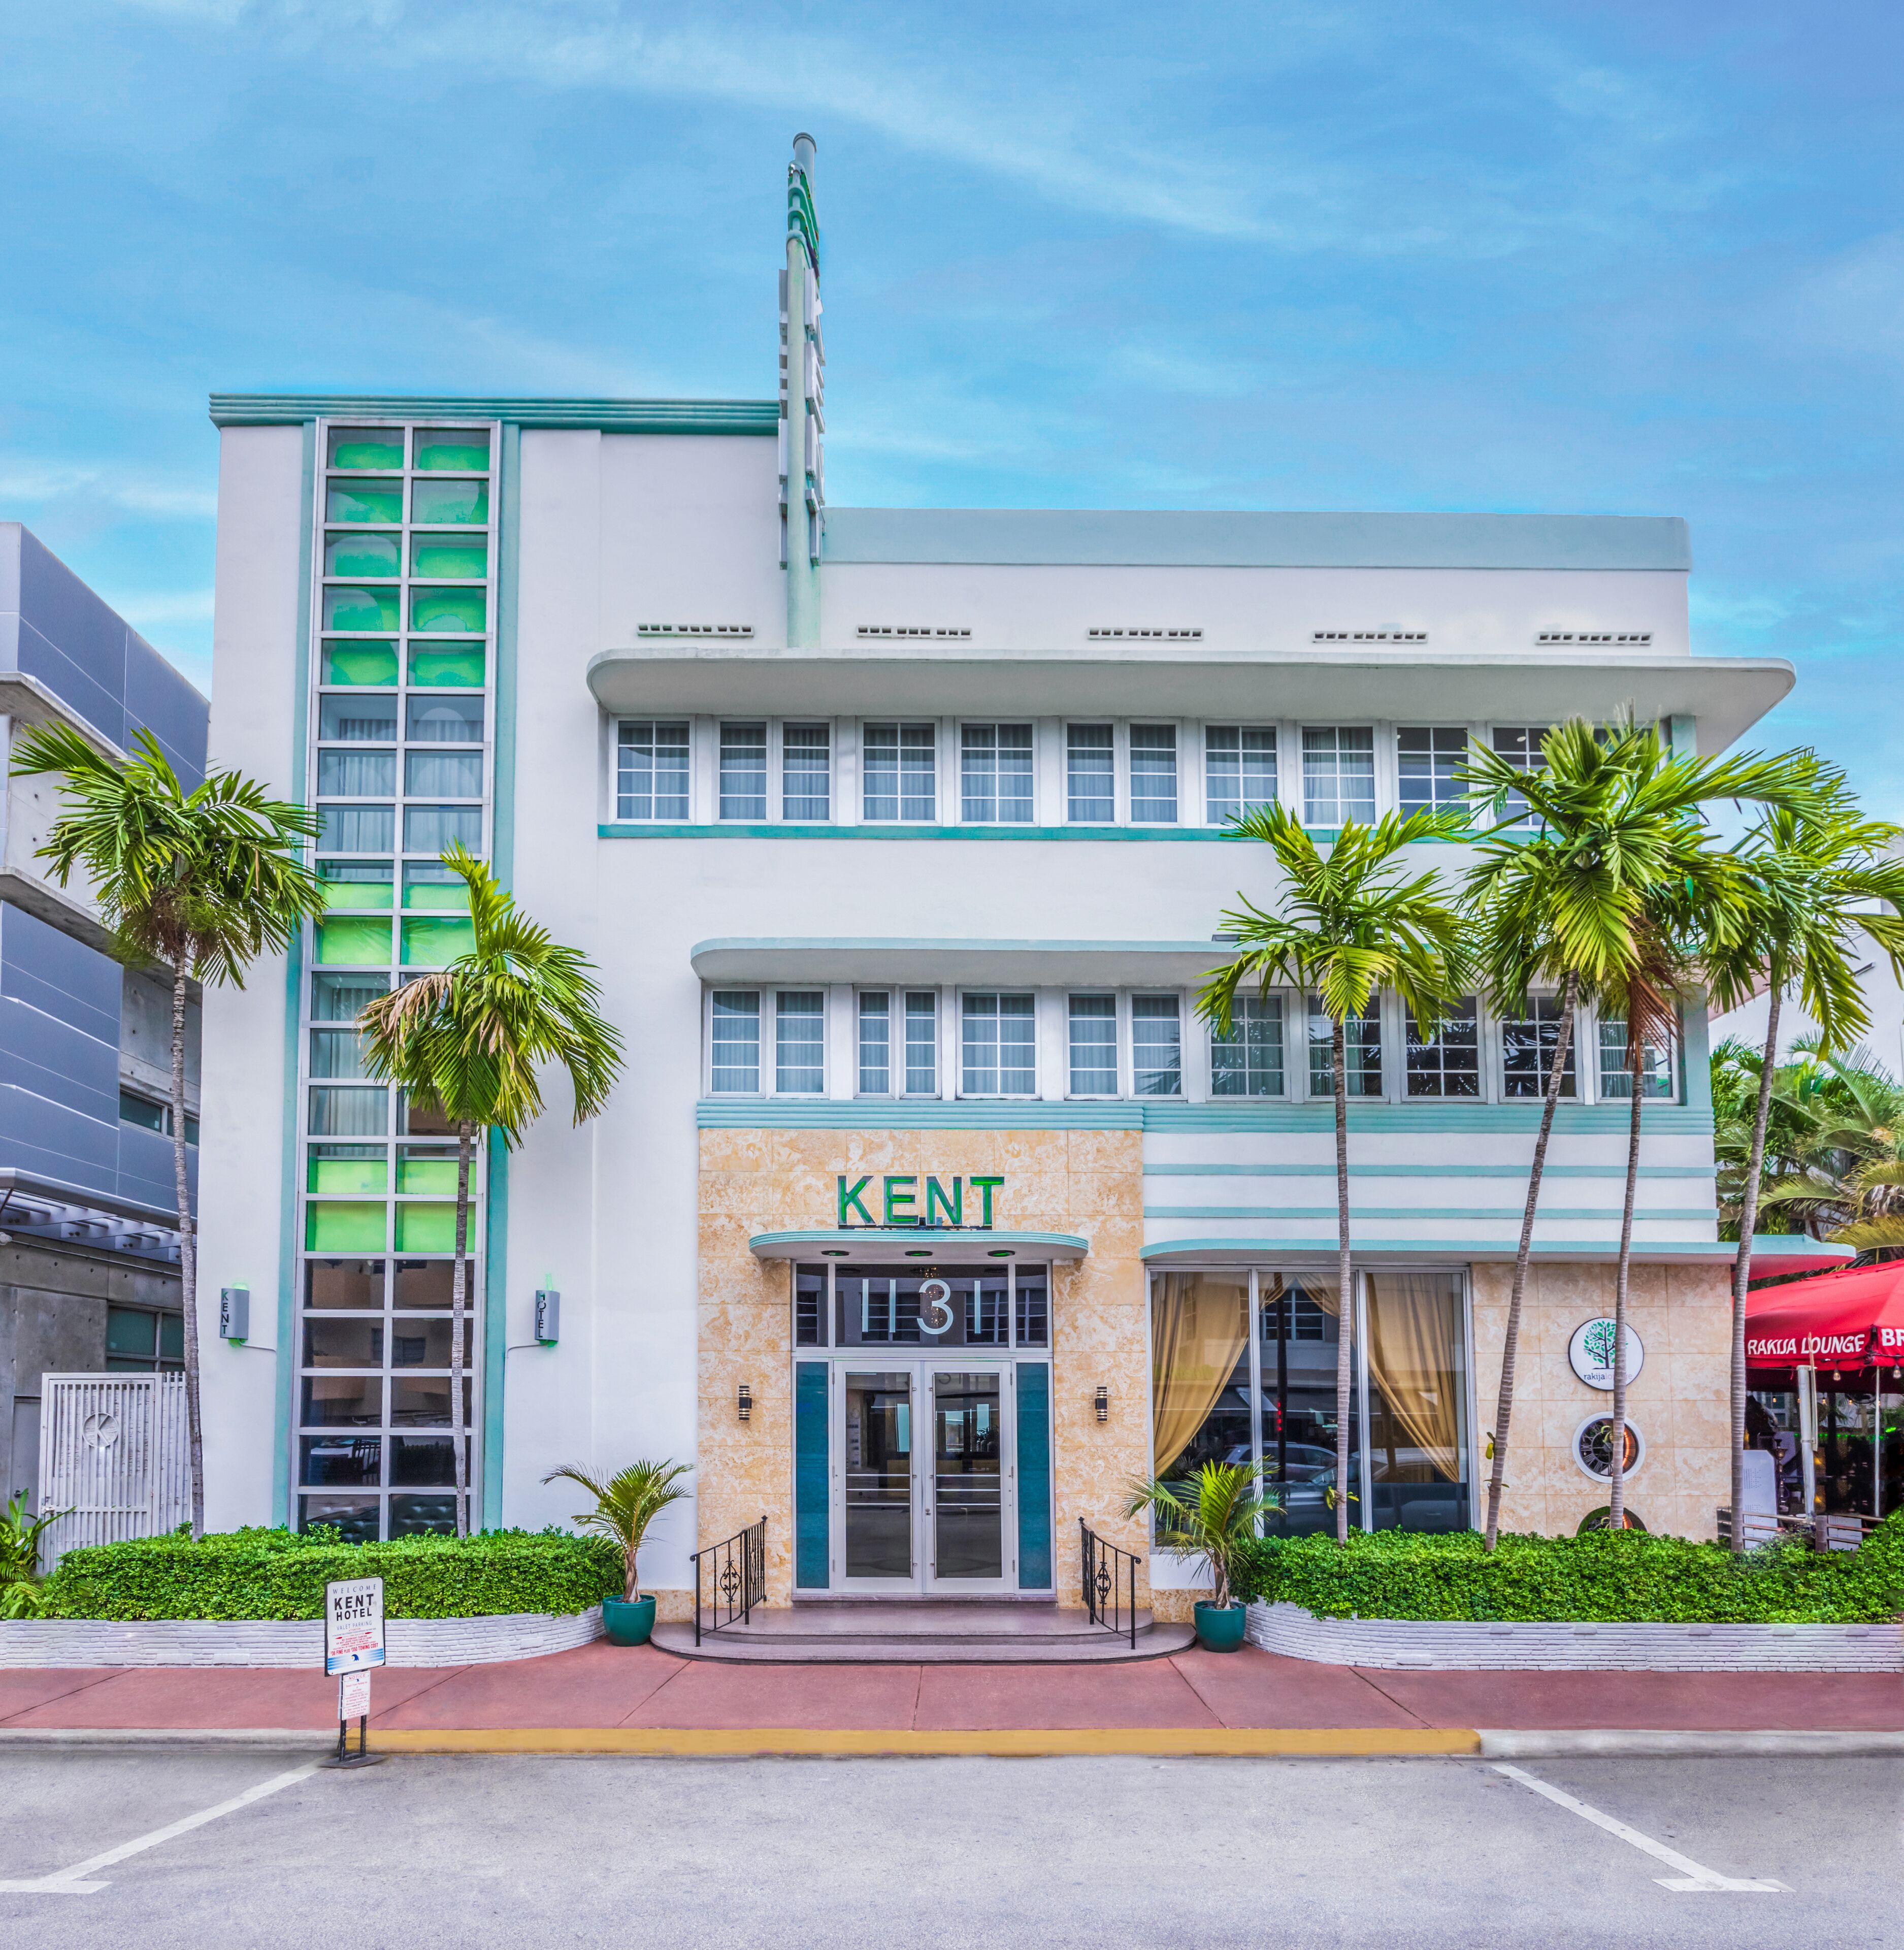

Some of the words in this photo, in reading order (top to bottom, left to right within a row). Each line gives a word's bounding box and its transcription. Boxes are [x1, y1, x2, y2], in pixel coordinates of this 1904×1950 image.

[837, 1175, 1005, 1226] KENT
[221, 1291, 229, 1335] KENT
[861, 1278, 981, 1335] 1131
[1747, 1338, 1797, 1355] RAKIJA
[1800, 1334, 1865, 1354] LOUNGE
[333, 1584, 376, 1594] WELCOME
[334, 1593, 374, 1611] KENT
[336, 1607, 372, 1621] HOTEL
